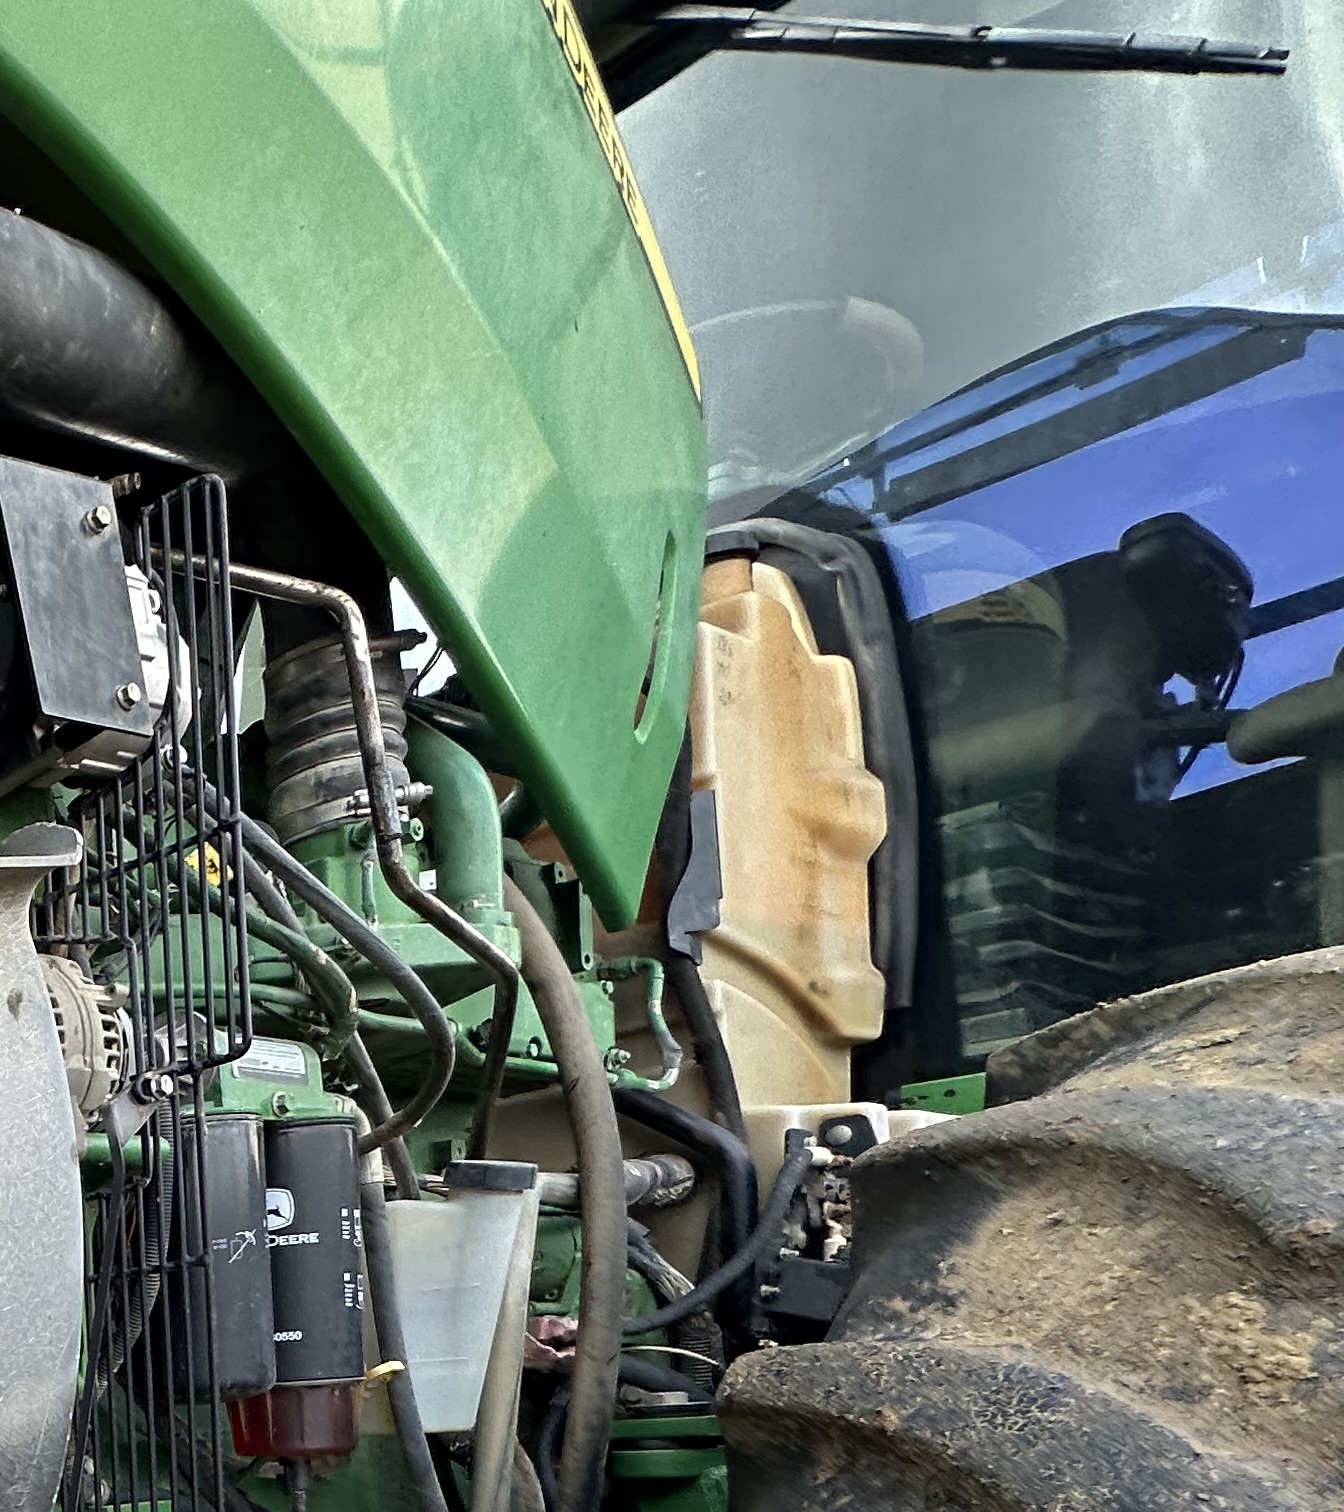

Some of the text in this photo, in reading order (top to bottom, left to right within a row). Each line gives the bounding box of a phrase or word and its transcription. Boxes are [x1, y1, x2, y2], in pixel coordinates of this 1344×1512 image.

[563, 5, 639, 225] DEERE
[267, 1232, 320, 1247] DEERE
[272, 1330, 303, 1342] 0550
